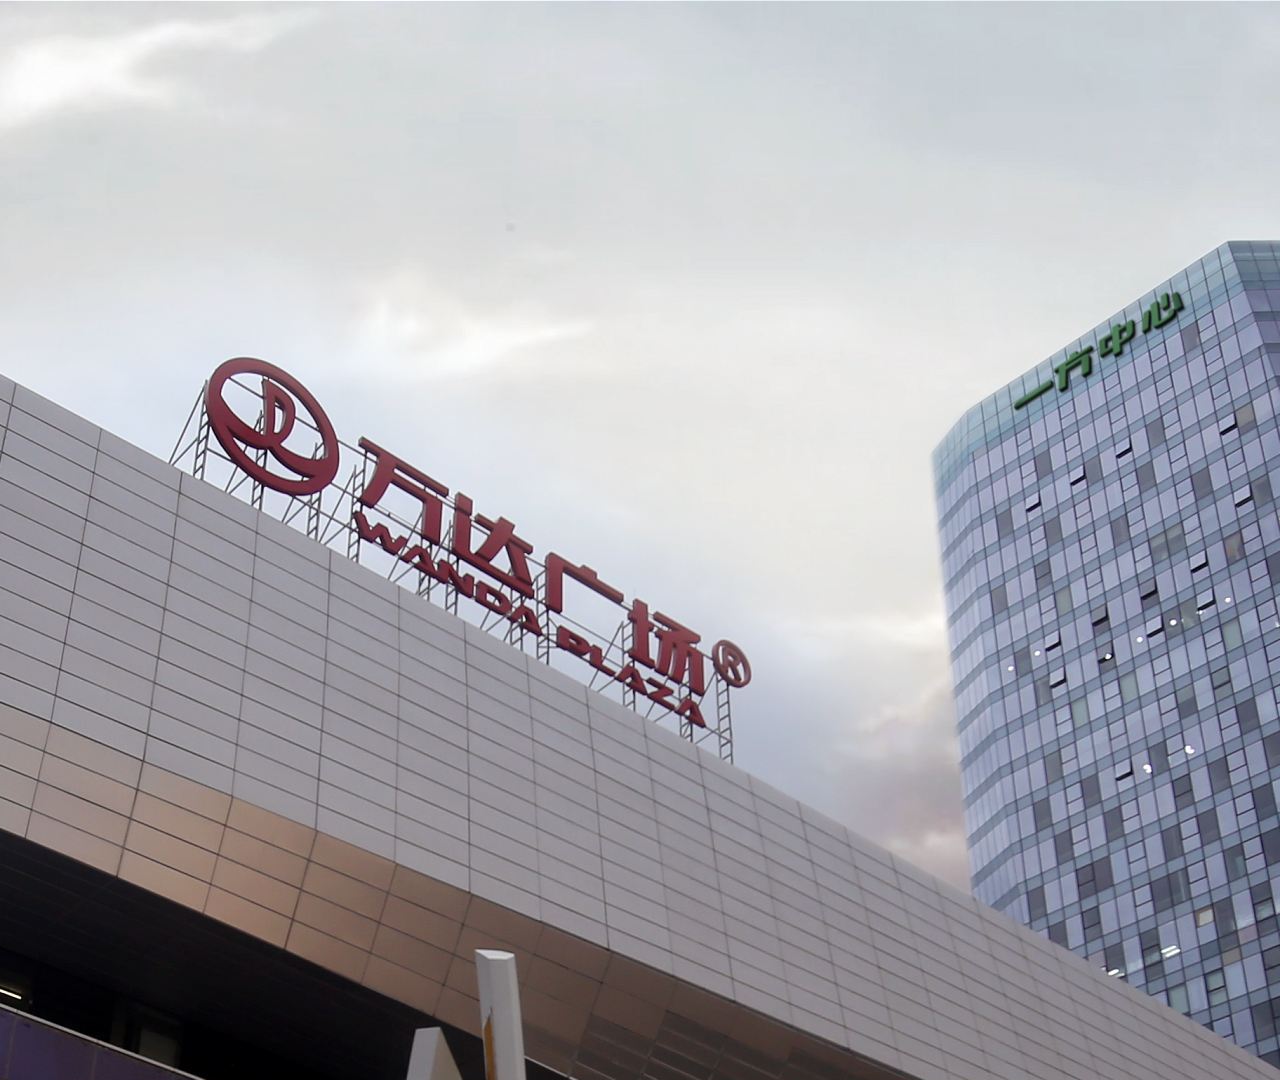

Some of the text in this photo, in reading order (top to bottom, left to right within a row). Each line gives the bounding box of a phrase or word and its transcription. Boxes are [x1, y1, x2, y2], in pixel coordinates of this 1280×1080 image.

[1014, 292, 1184, 410] 一方中心
[354, 510, 707, 728] WANDA PLAZA
[357, 436, 705, 697] 万达广场
